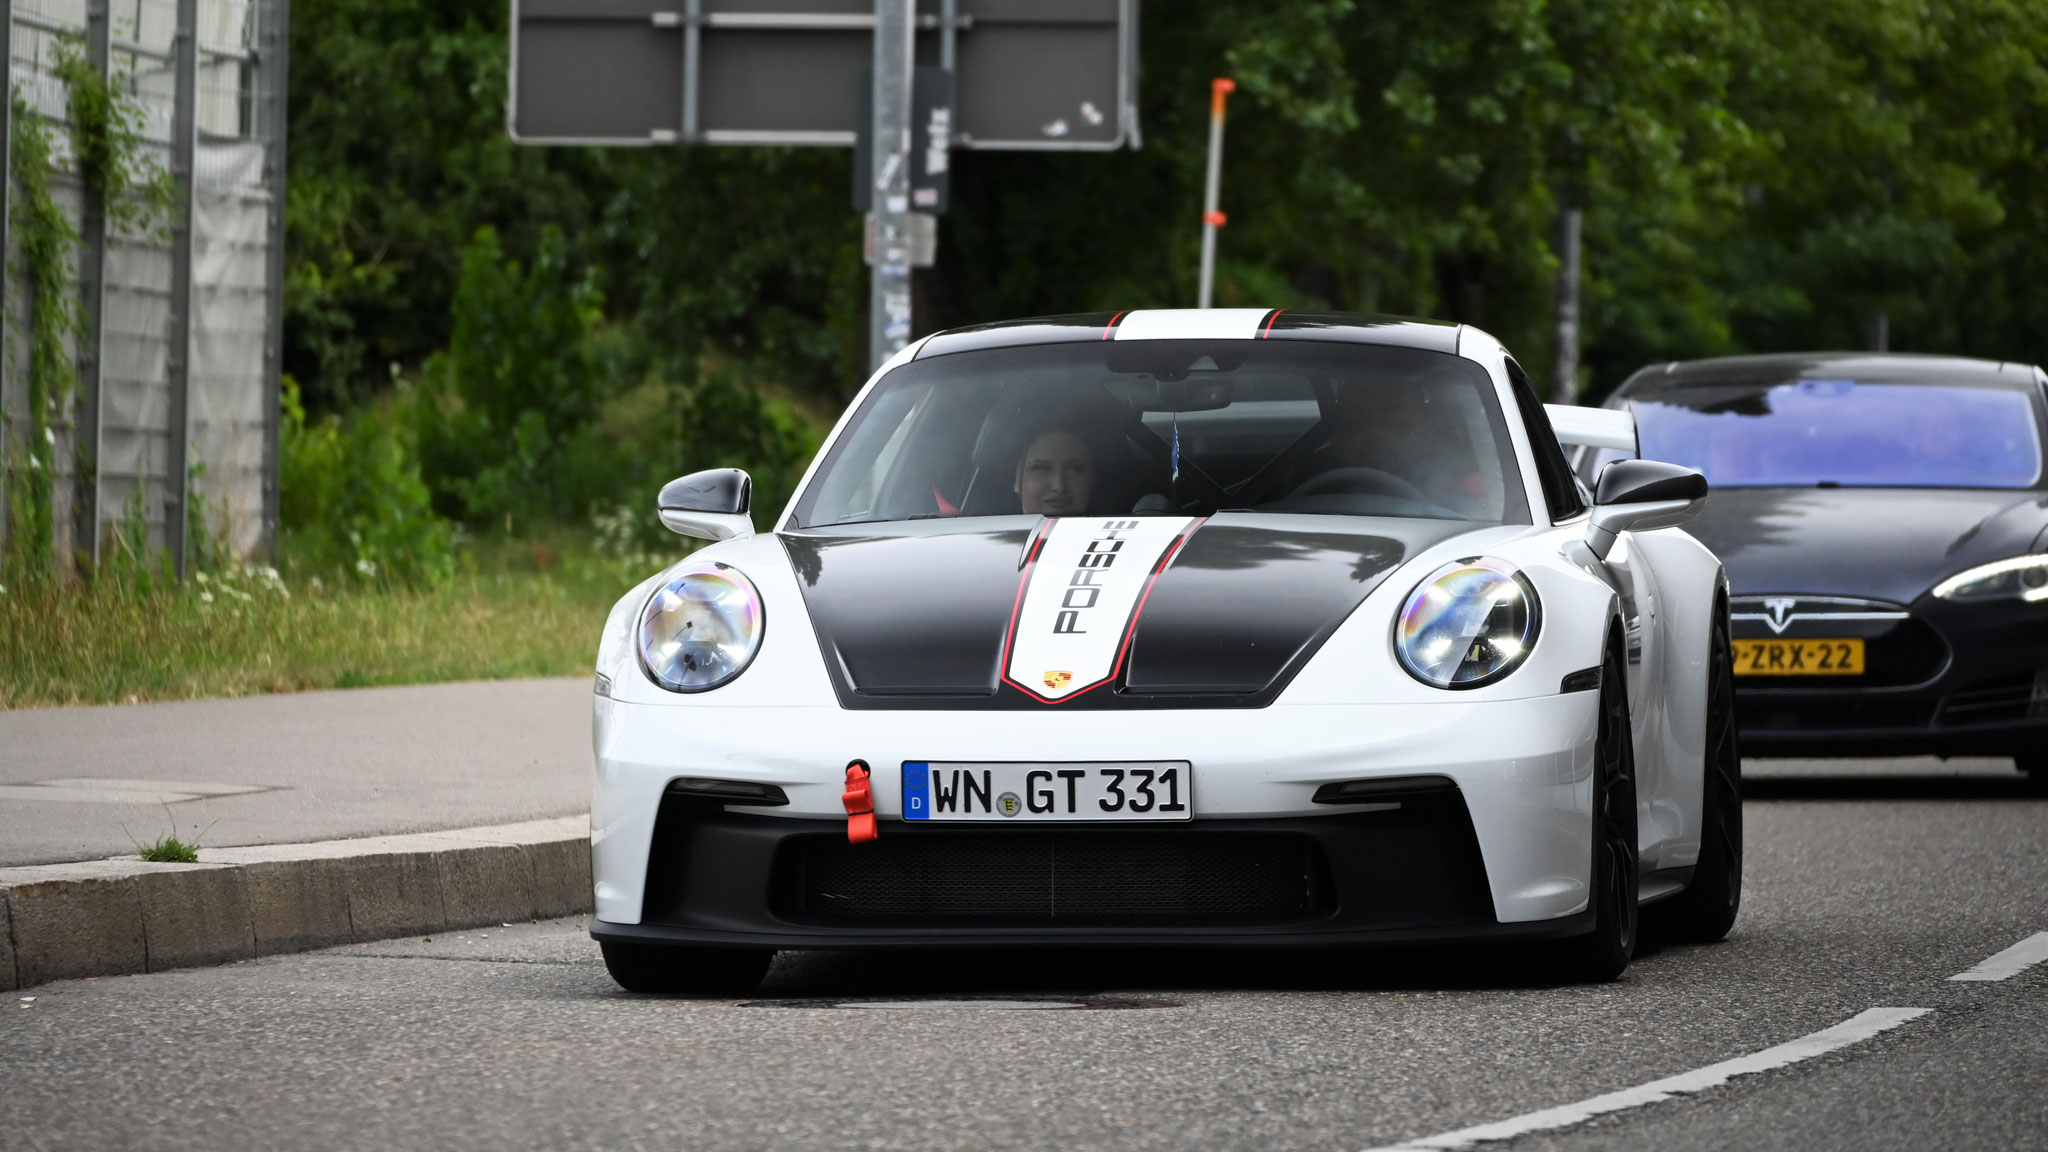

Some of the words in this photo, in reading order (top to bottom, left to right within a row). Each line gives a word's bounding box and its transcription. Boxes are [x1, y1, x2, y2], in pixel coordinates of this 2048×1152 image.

[1053, 520, 1140, 634] PORSCHE
[911, 796, 922, 810] D
[932, 769, 992, 813] WN
[1026, 769, 1086, 813] GT
[1098, 768, 1185, 812] 331
